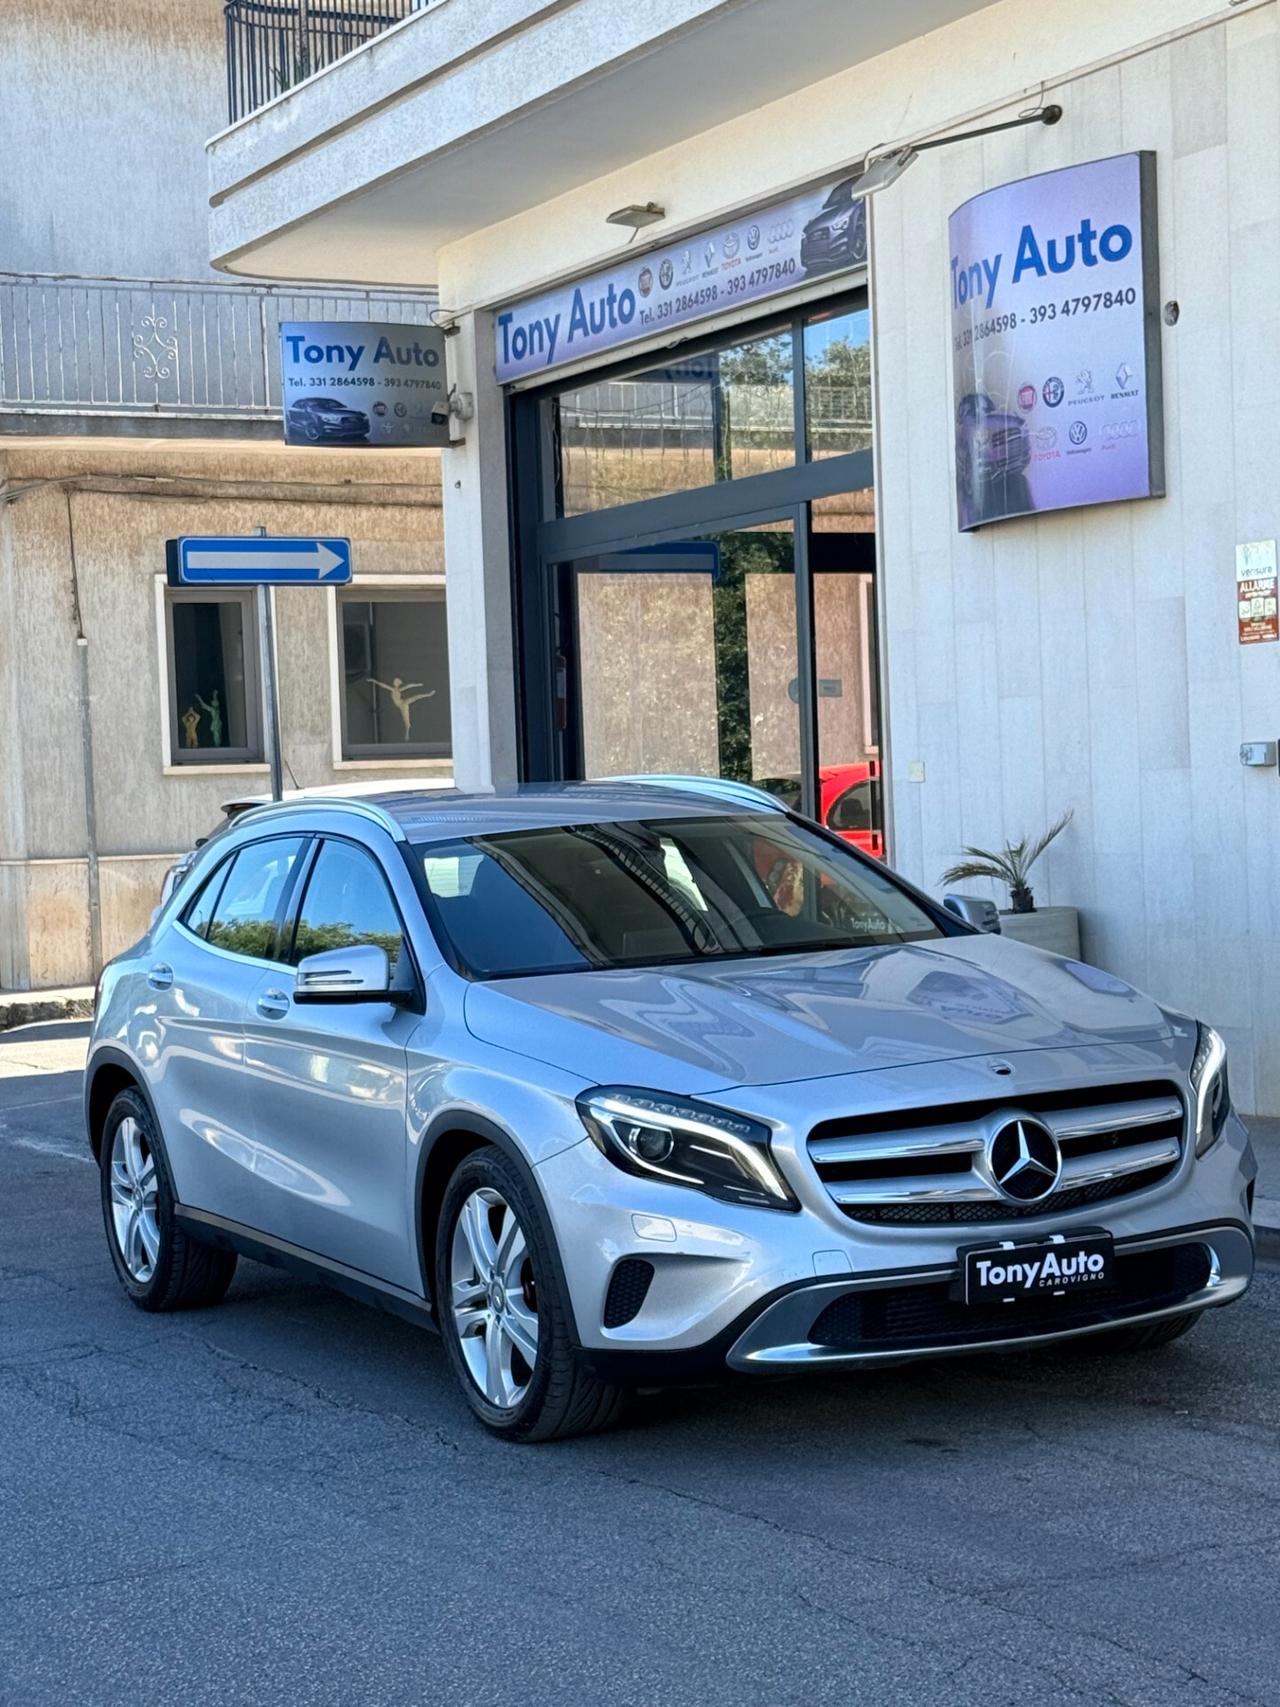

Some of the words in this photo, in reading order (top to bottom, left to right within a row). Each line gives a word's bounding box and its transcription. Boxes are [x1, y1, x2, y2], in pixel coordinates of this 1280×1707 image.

[951, 253, 1002, 309] Tony
[1012, 219, 1132, 284] Auto
[639, 308, 655, 325] Tel.
[657, 302, 673, 319] 331
[675, 285, 718, 313] 2864598
[727, 276, 746, 295] 393
[749, 258, 795, 286] 4797840
[498, 312, 561, 364] Tony
[567, 283, 636, 343] Auto
[974, 313, 1017, 342] 2864598
[1030, 303, 1056, 324] 393
[1061, 287, 1136, 317] 4797840
[286, 335, 365, 371] Tony
[373, 336, 440, 367] Auto
[288, 377, 306, 387] Tel.
[309, 377, 326, 387] 331
[329, 377, 375, 387] 2864598
[384, 378, 401, 388] 393
[403, 378, 442, 390] 4797840
[1067, 395, 1105, 406] PEUGEOT
[1110, 389, 1139, 400] RENAULT
[1039, 1272, 1105, 1287] CAROVIGNO
